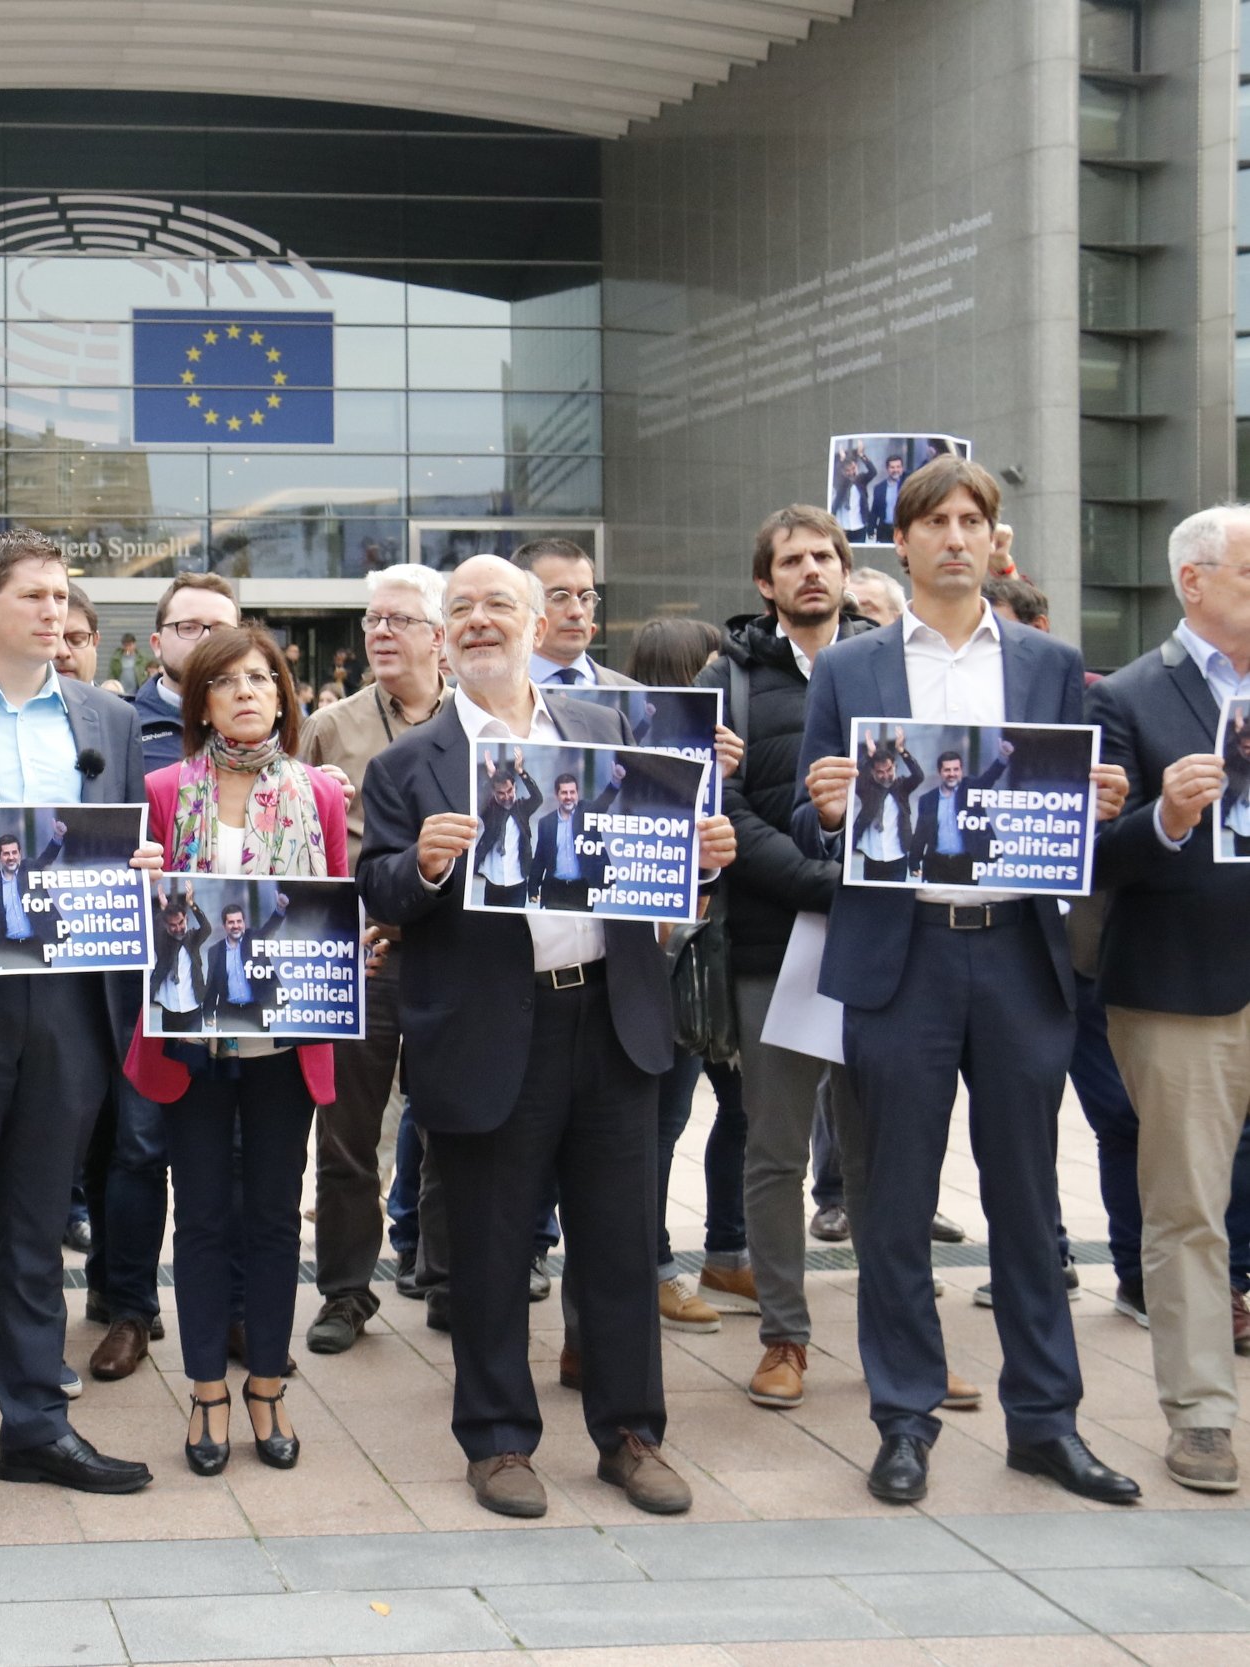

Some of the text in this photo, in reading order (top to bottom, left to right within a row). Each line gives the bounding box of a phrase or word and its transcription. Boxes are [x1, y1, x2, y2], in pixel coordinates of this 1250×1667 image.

[60, 536, 191, 563] iero Spinelli
[967, 789, 1082, 811] FREEDOM
[584, 813, 688, 837] FREEDOM
[957, 811, 1080, 834] for Catalan
[575, 835, 685, 860] for Catalan
[990, 836, 1078, 857] political
[29, 869, 136, 889] FREEDOM
[604, 862, 684, 884] political
[972, 858, 1077, 880] prisoners
[22, 890, 138, 912] for Catalan
[588, 884, 683, 907] prisoners
[57, 913, 139, 938] political
[44, 938, 141, 962] prisoners
[252, 940, 353, 957] FREEDOM
[244, 960, 352, 979] for Catalan
[277, 983, 352, 1004] political
[263, 1004, 353, 1026] prisoners
